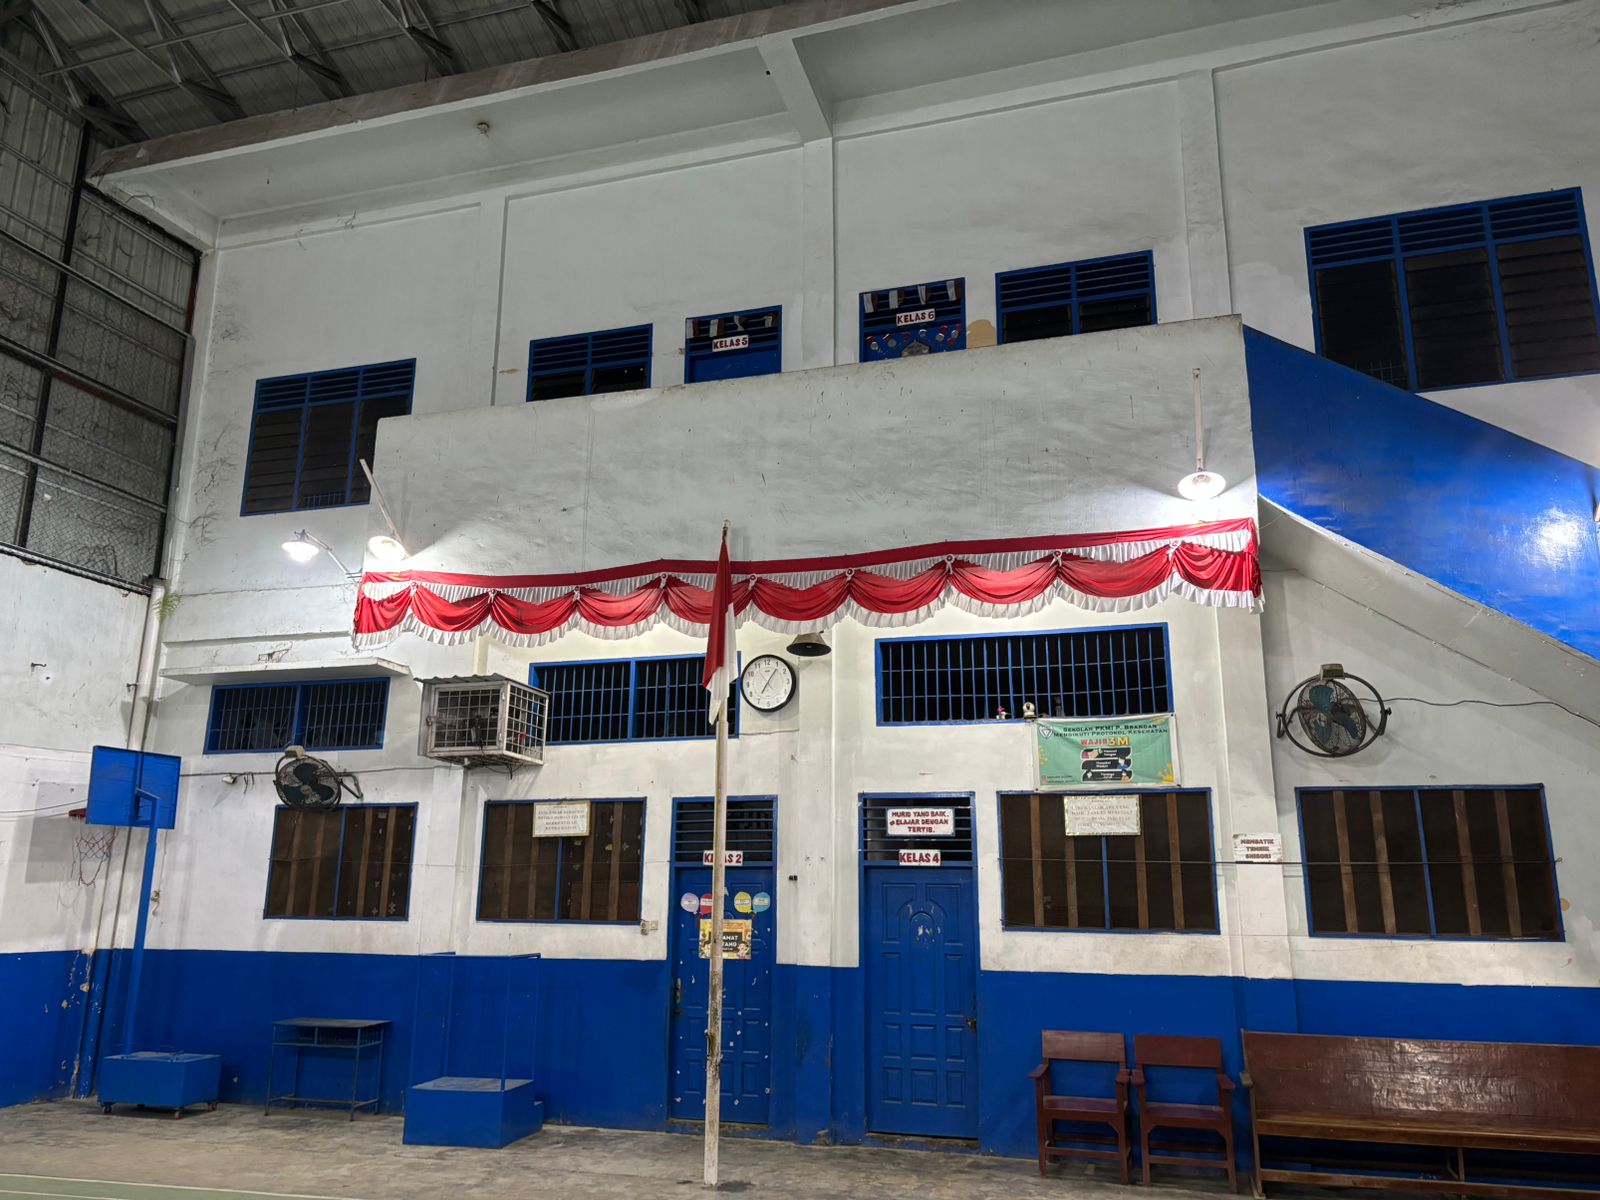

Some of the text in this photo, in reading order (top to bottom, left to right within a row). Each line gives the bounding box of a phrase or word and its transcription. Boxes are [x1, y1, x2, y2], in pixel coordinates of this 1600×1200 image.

[898, 311, 934, 324] KELAS 6
[714, 337, 748, 350] KELAS 5
[1109, 736, 1115, 746] 3
[1118, 736, 1129, 746] M
[736, 854, 742, 863] 2
[900, 853, 939, 863] KELAS 4
